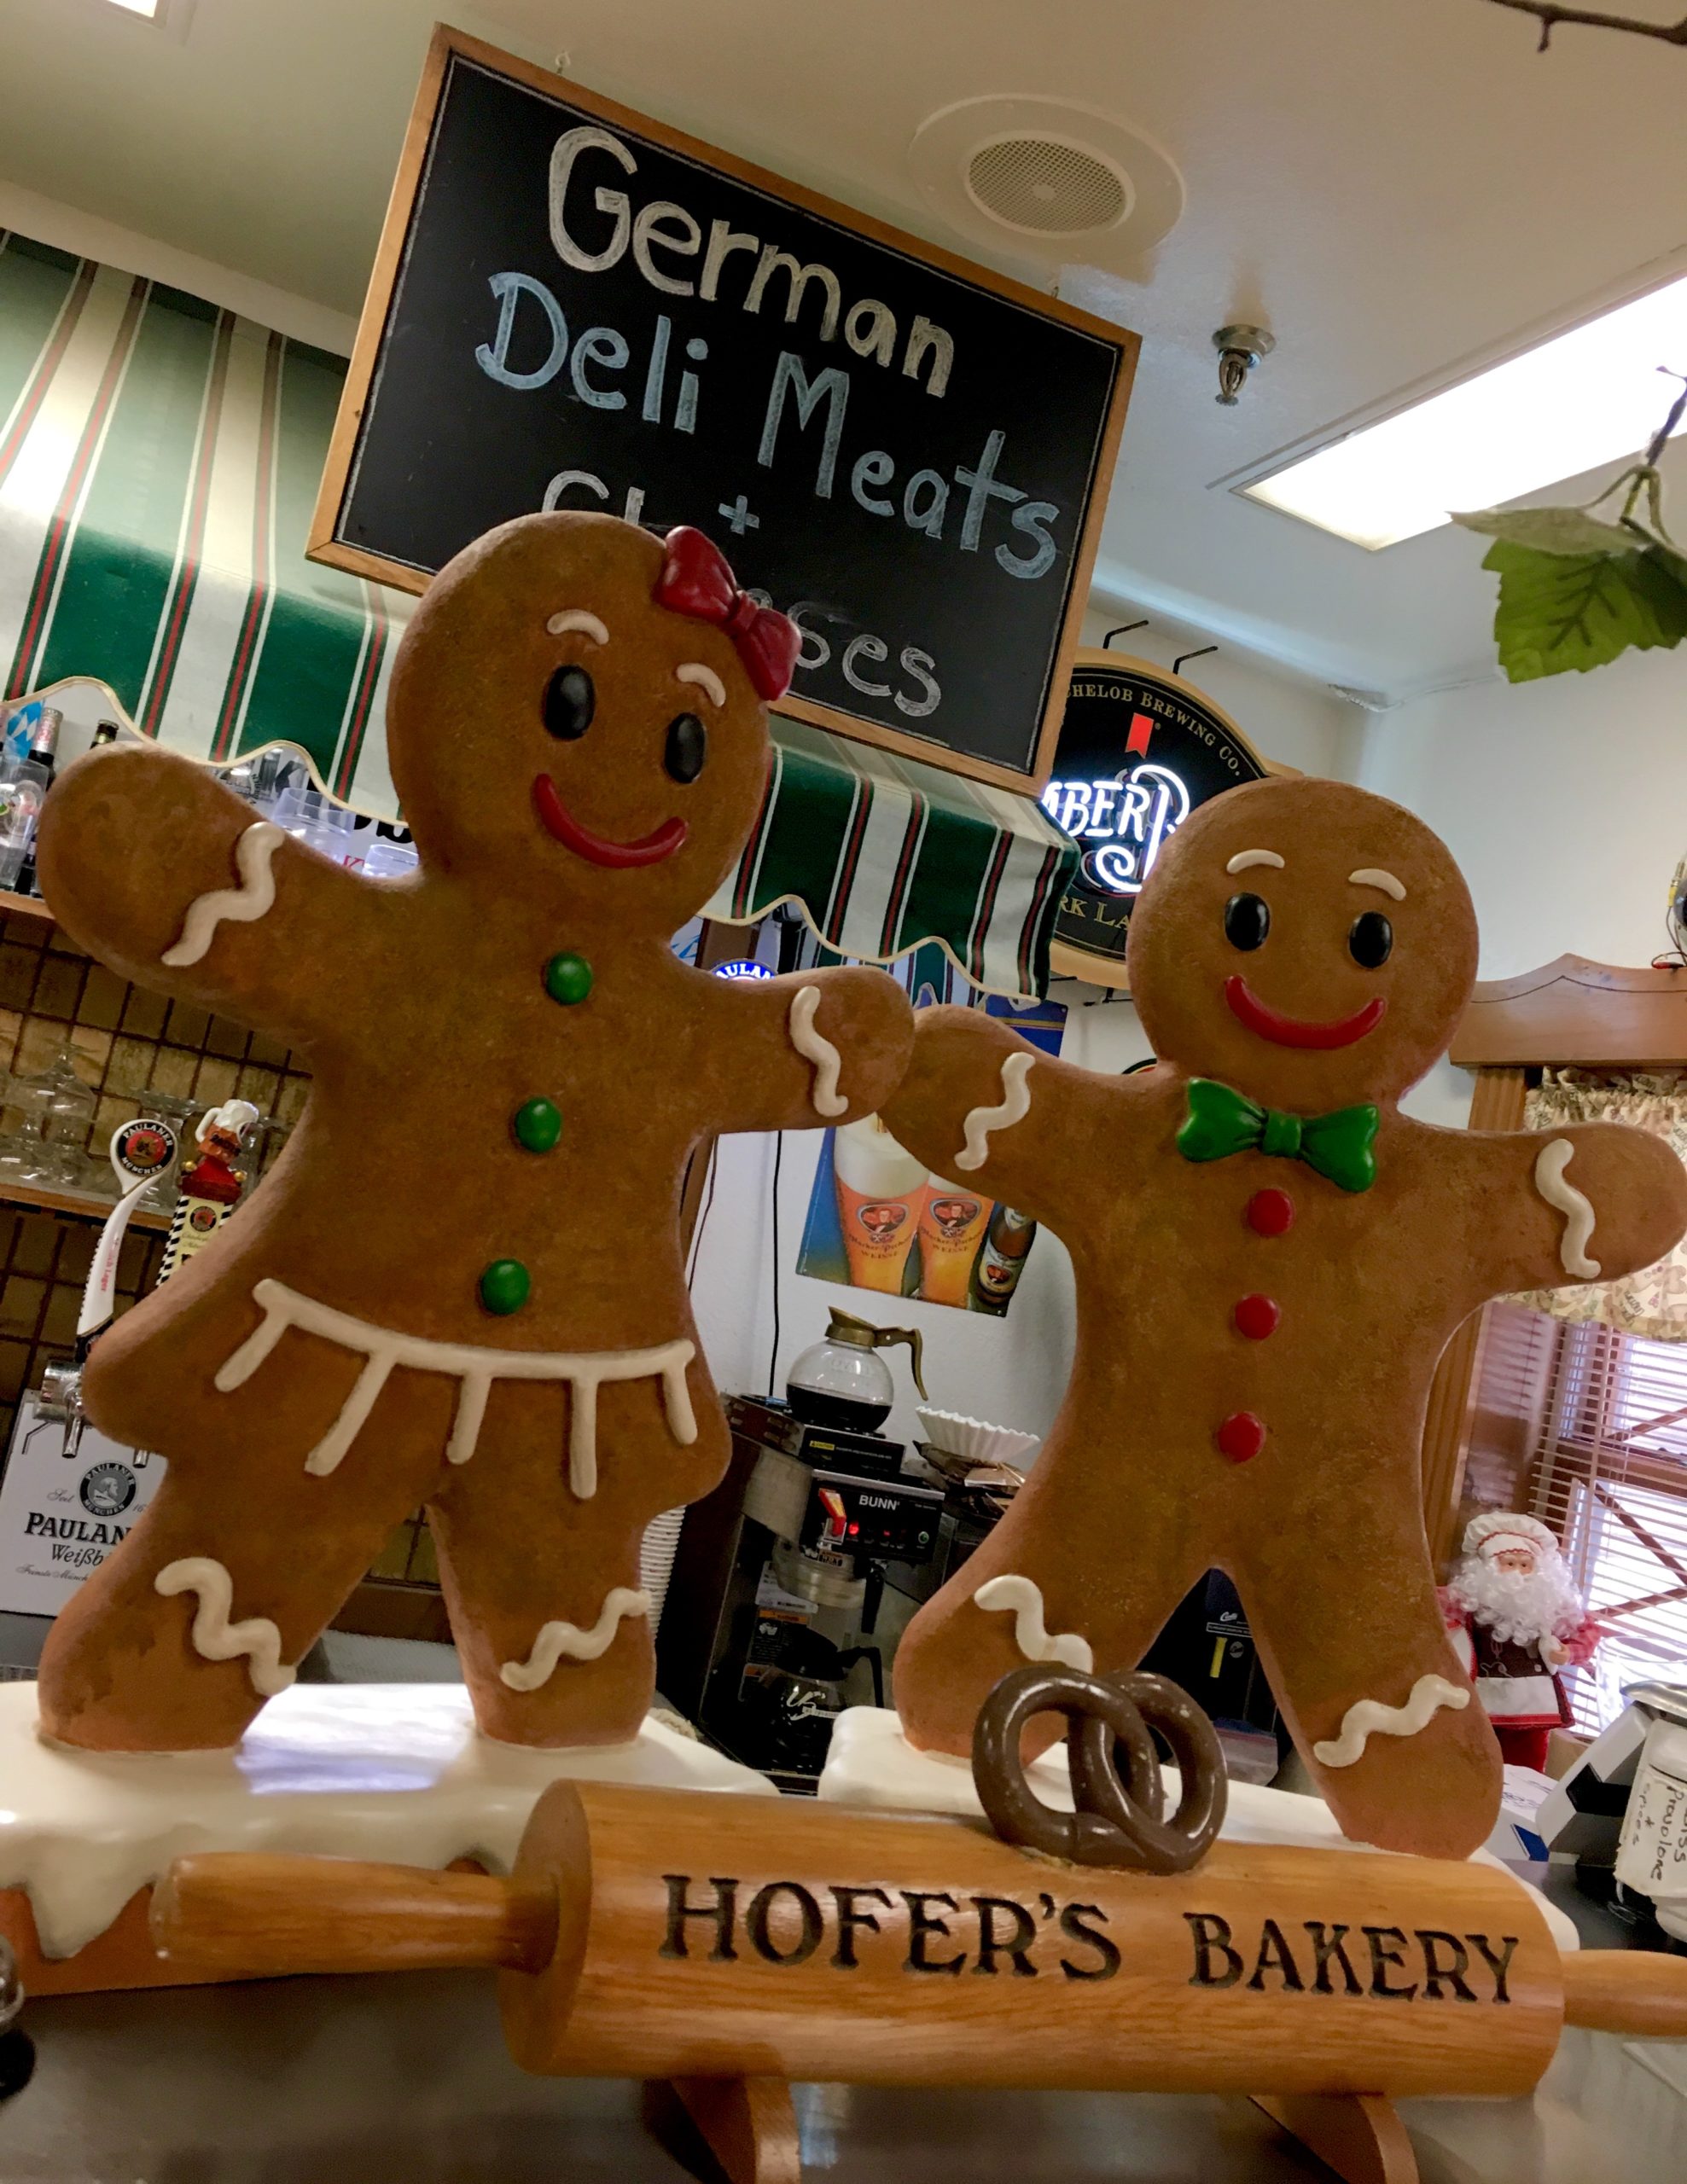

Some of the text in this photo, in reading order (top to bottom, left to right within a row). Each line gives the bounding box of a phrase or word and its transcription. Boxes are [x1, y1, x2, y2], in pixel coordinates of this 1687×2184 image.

[549, 126, 954, 398] German
[475, 271, 1060, 579] Deli Meats
[1067, 684, 1241, 776] HELOB BREWING CO.
[122, 1122, 174, 1147] PAULANER
[85, 1462, 135, 1485] PAULANER
[858, 1494, 898, 1511] BUNN
[51, 1543, 110, 1567] Weißb
[1649, 1785, 1684, 1881] Provolone
[658, 1873, 1519, 2004] HOFER'S BAKERY
